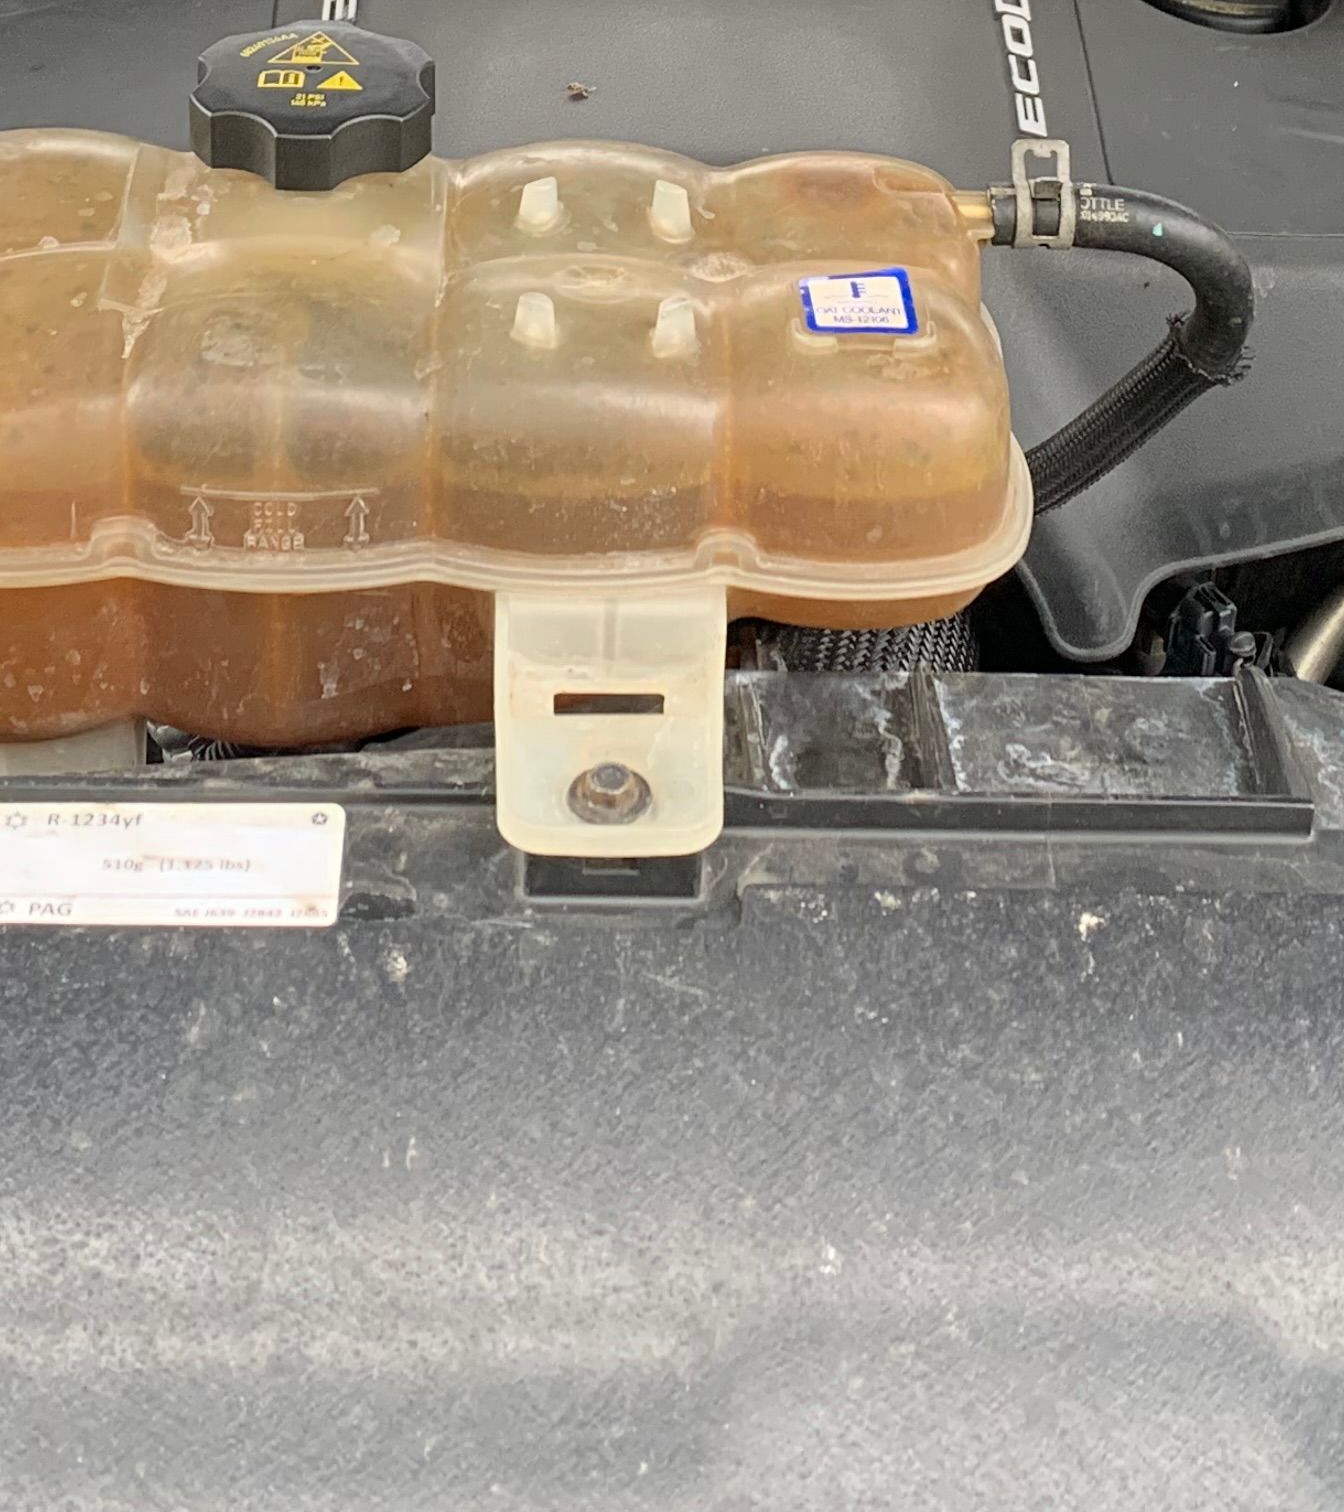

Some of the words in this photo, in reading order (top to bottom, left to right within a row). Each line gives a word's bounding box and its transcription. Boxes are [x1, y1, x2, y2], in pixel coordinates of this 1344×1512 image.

[842, 306, 902, 316] COOLANT
[253, 502, 298, 517] COLD
[244, 532, 305, 551] RANGE
[47, 813, 145, 830] R-1234yf
[28, 903, 73, 917] PAG
